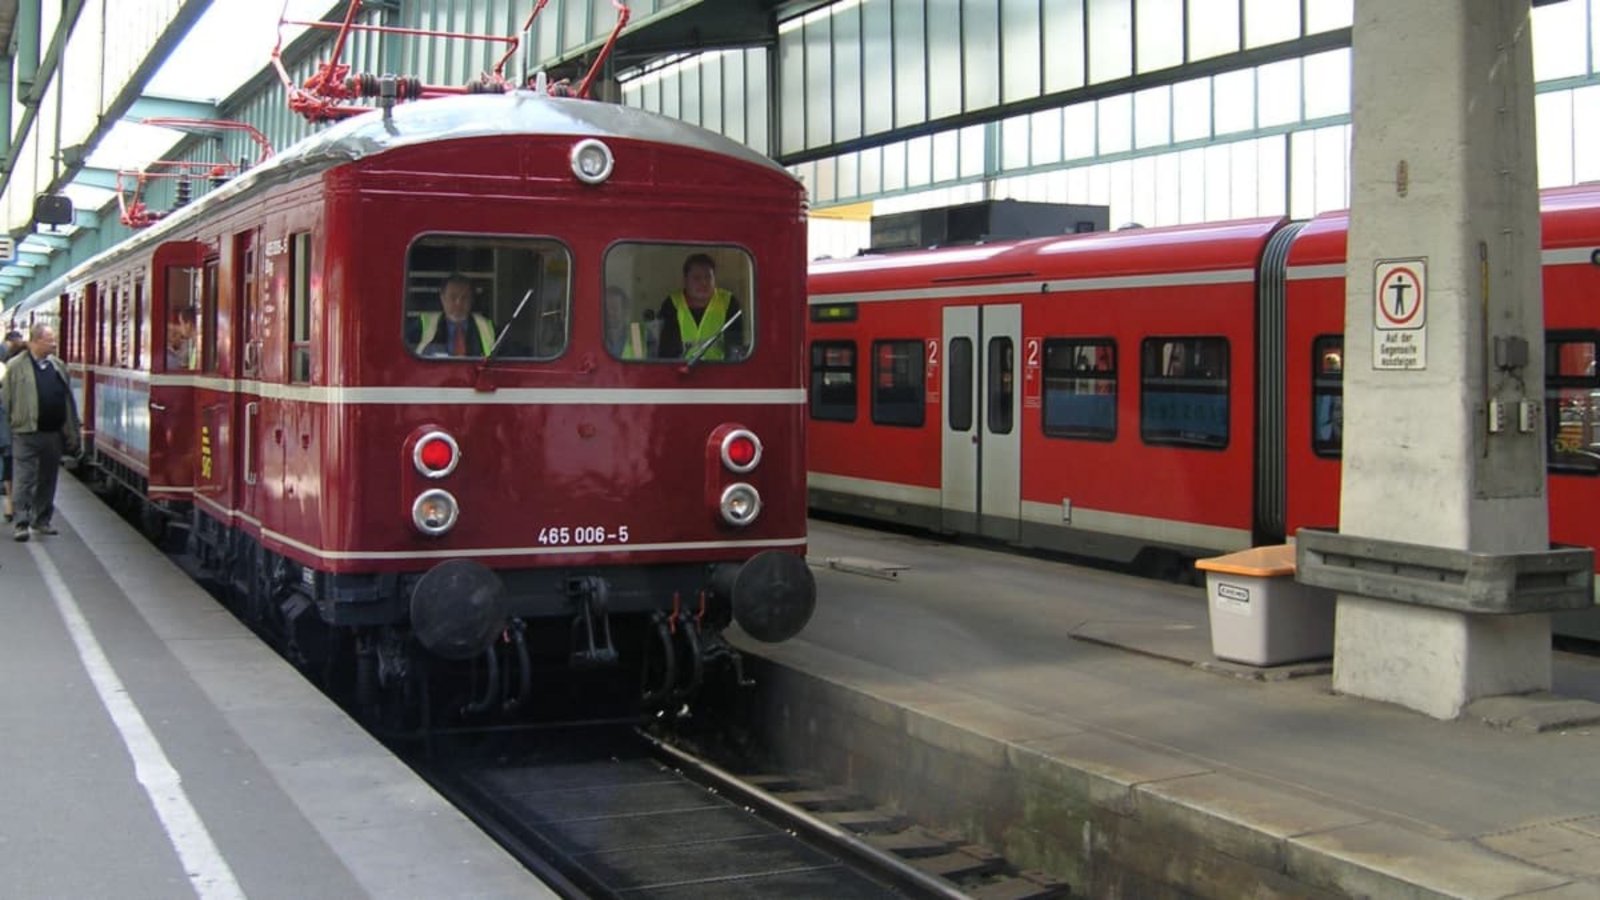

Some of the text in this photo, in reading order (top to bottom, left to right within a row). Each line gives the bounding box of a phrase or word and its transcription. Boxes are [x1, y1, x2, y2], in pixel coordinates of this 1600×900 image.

[1386, 332, 1413, 342] Auf der
[928, 340, 937, 364] 2
[1028, 340, 1038, 365] 2
[538, 527, 570, 545] 465
